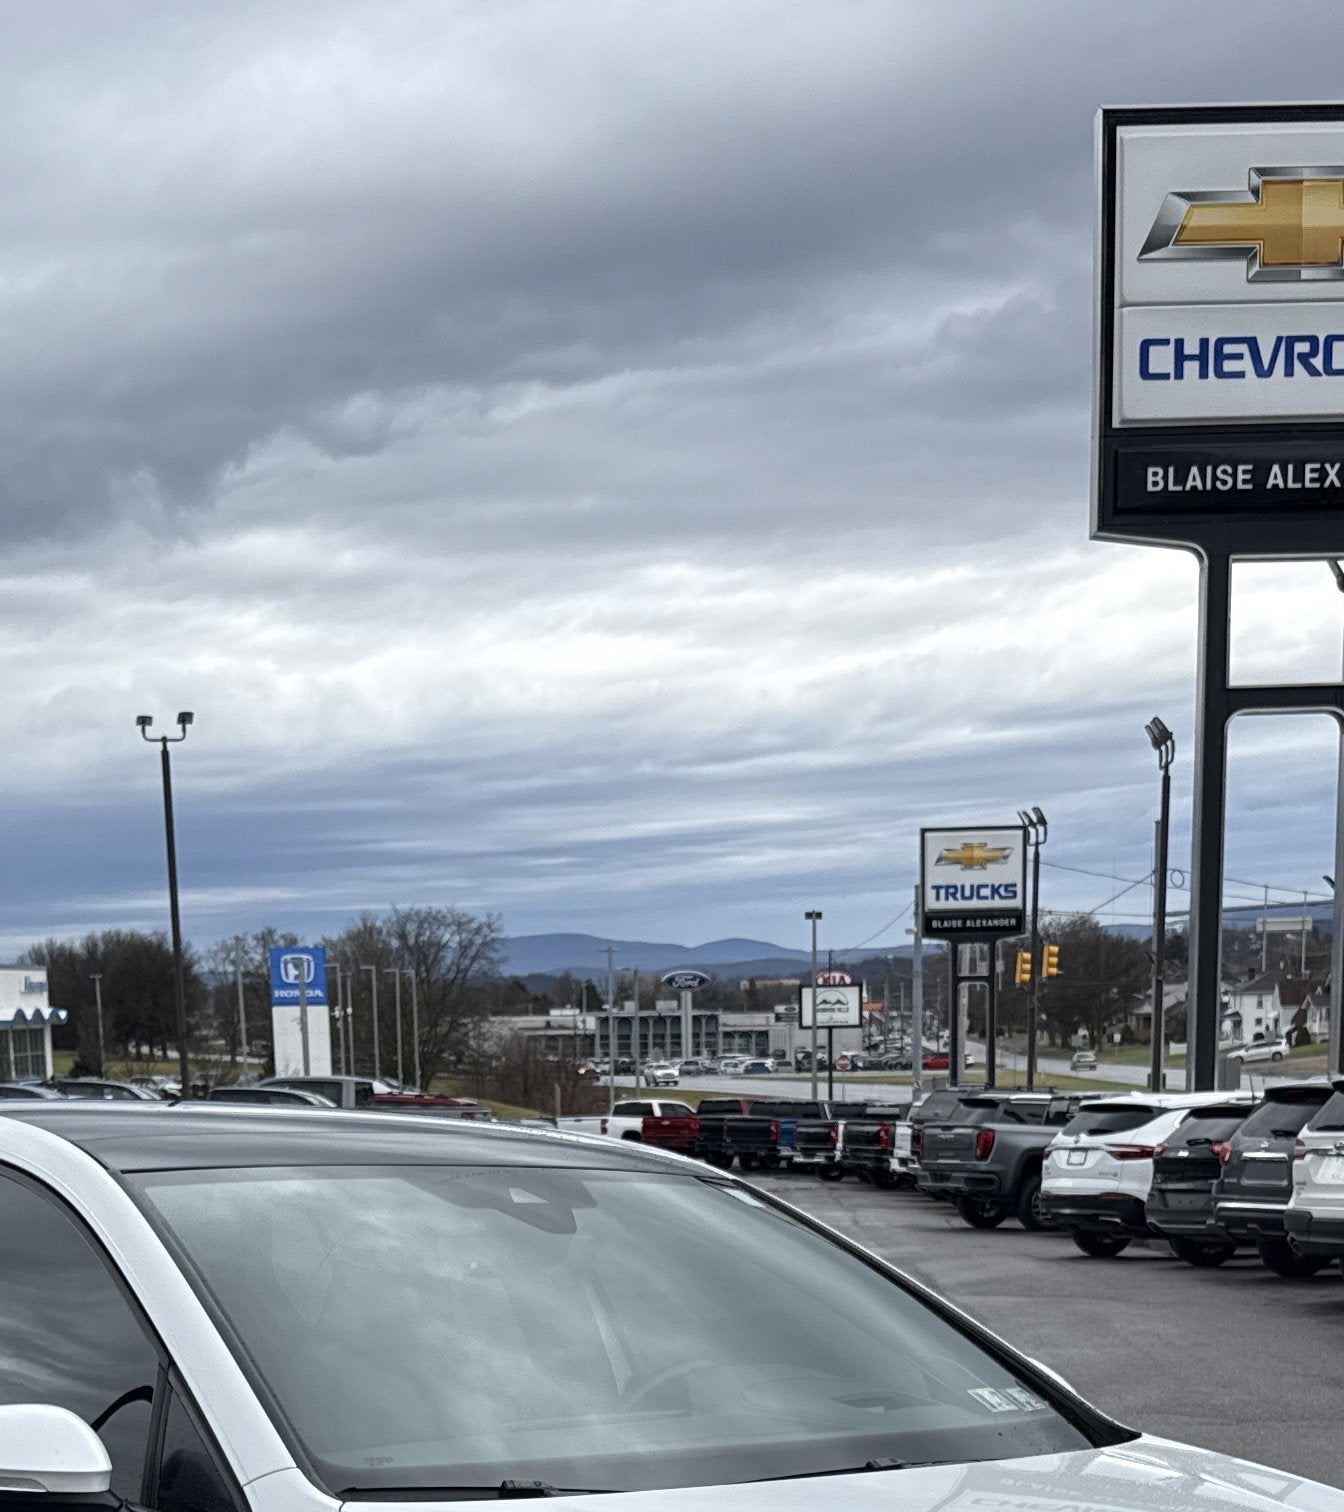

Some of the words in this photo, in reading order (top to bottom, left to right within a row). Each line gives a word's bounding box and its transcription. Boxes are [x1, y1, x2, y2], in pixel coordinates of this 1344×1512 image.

[1146, 464, 1254, 492] BLAISE
[931, 883, 1017, 901] TRUCKS
[932, 920, 962, 929] BLAISE
[966, 918, 1016, 928] ALEXANDER
[672, 975, 701, 988] Ford
